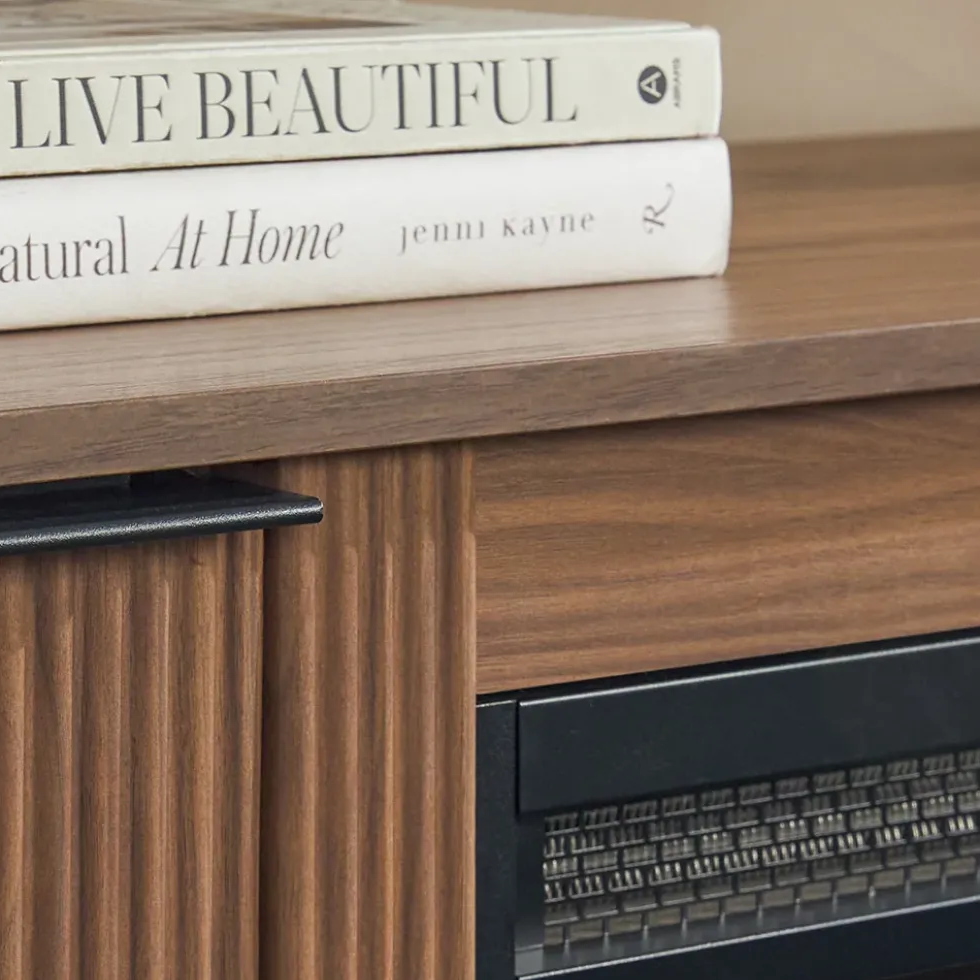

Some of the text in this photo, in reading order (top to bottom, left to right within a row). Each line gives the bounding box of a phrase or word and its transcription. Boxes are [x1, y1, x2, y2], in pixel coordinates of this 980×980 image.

[9, 73, 173, 149] LIVE
[194, 56, 578, 140] BEAUTIFUL
[150, 213, 208, 272] At
[218, 208, 344, 267] Home
